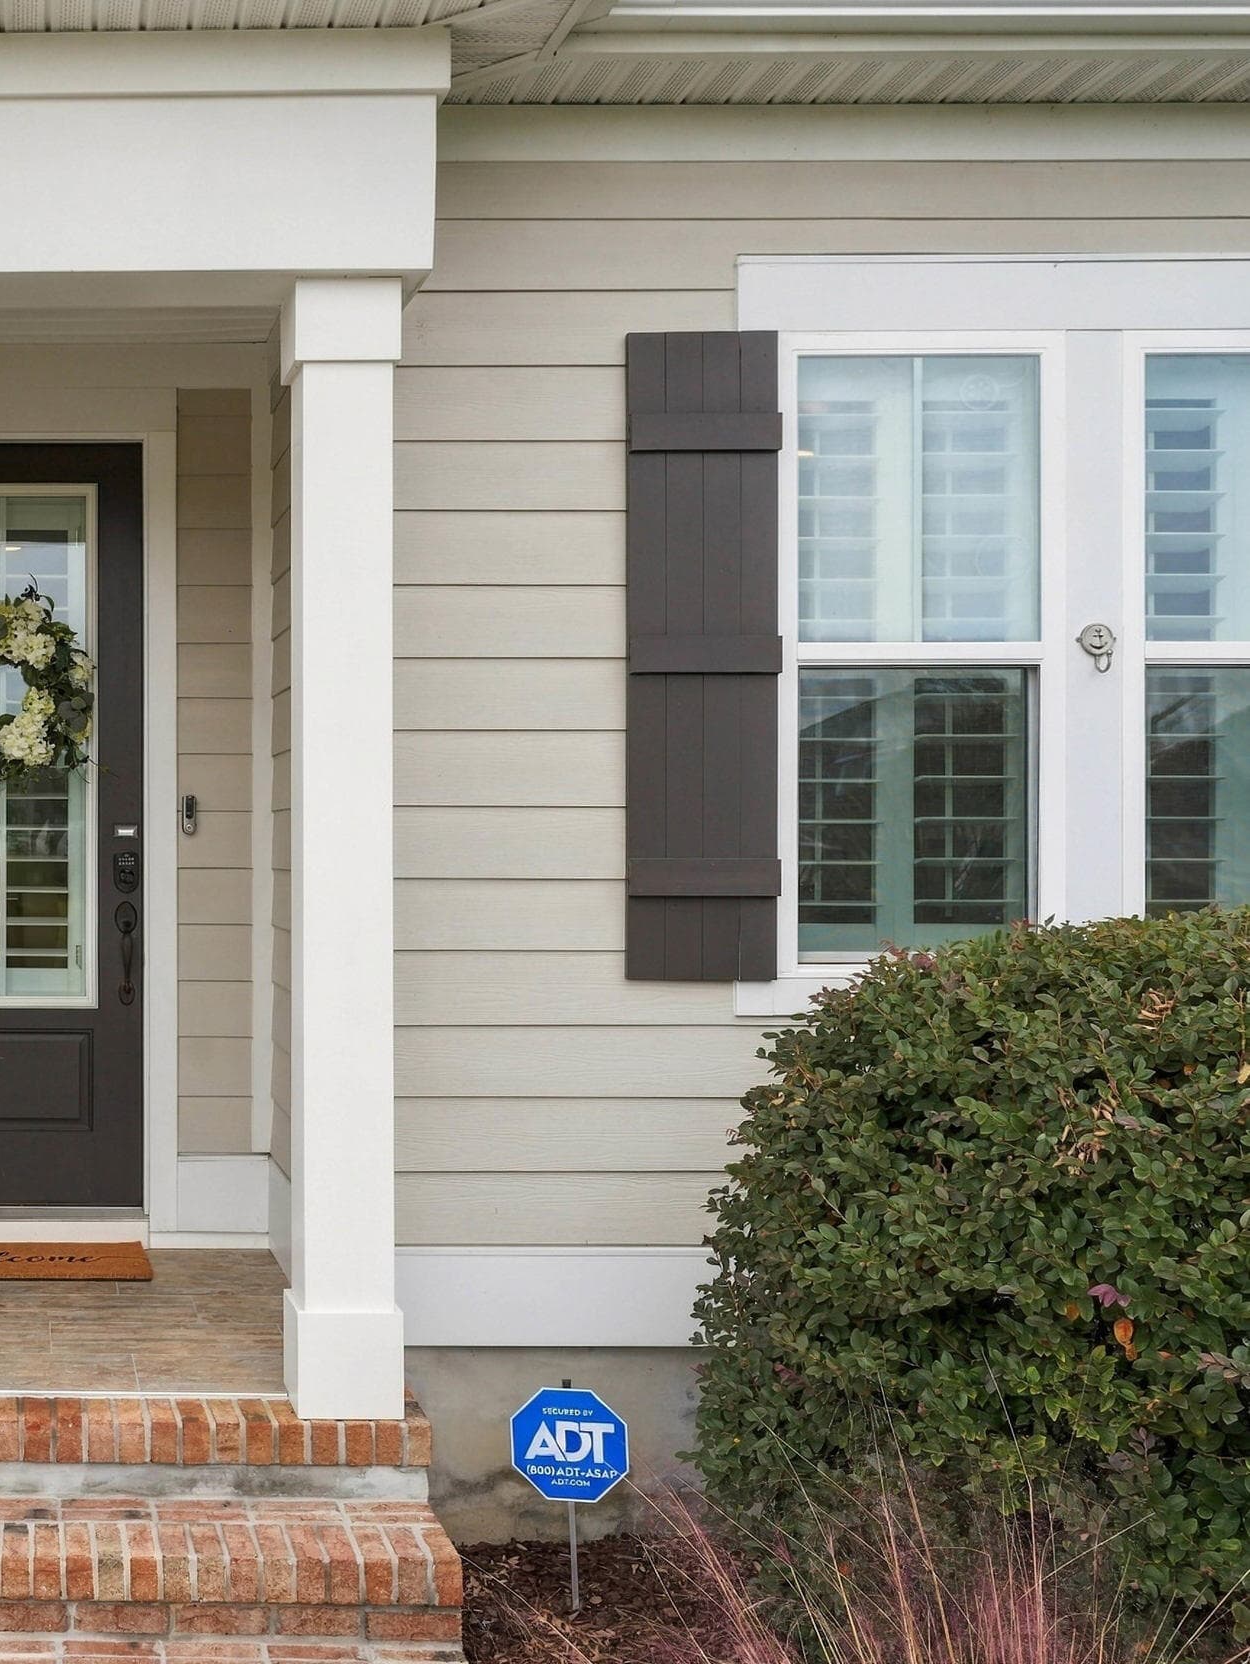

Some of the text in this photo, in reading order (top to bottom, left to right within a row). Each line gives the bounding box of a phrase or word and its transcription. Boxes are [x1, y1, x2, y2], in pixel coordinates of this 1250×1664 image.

[542, 1407, 581, 1416] SECURED
[524, 1420, 615, 1464] ADT
[551, 1478, 591, 1487] ADT.COM
